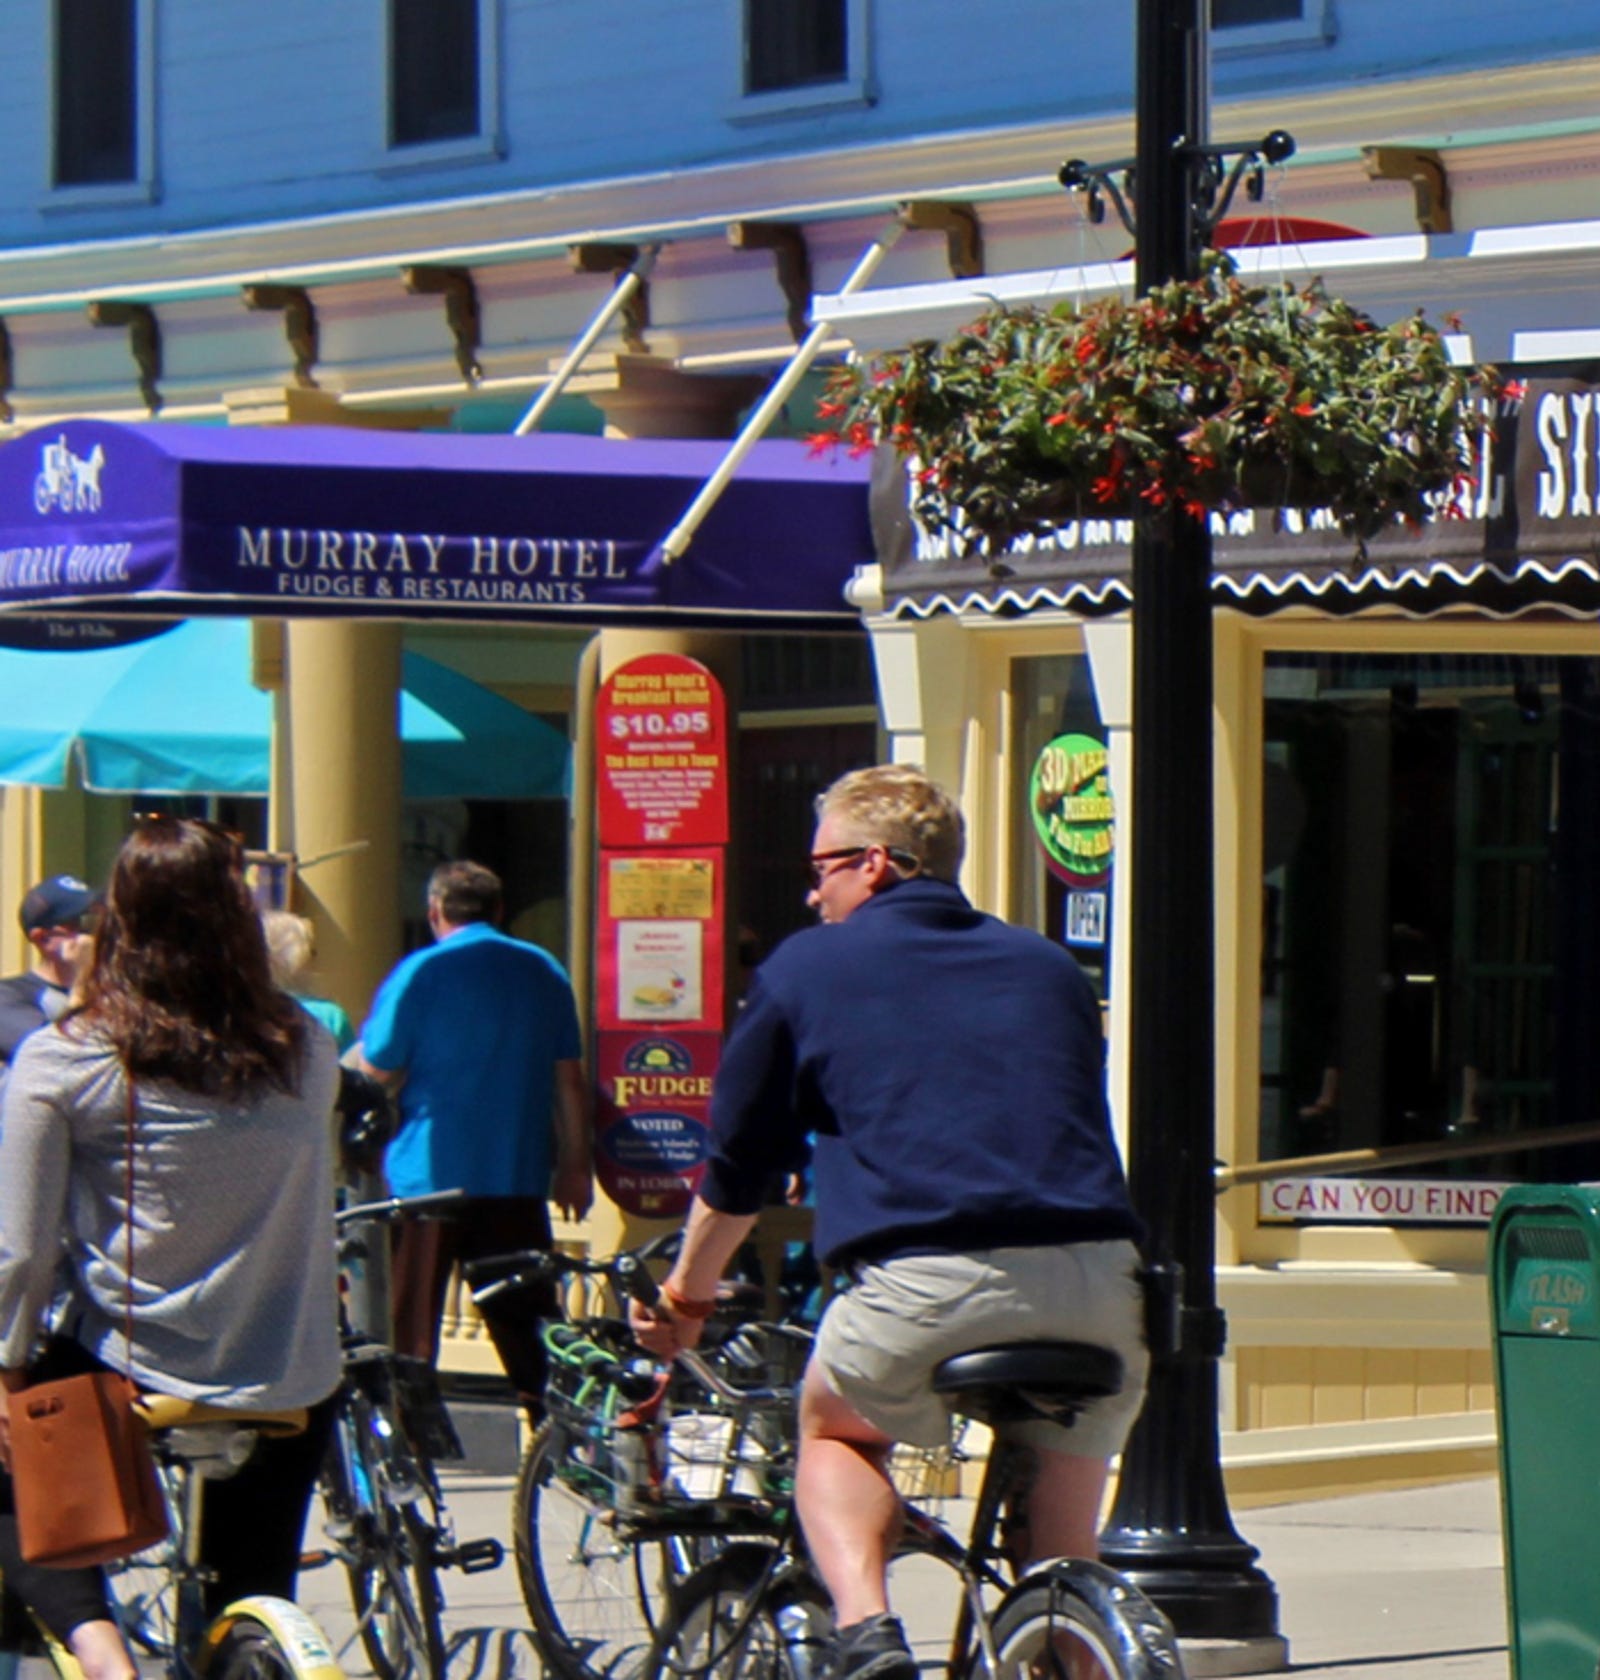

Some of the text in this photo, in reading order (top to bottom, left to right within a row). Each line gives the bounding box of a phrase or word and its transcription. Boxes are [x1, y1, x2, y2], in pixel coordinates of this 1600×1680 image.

[237, 526, 627, 578] MURRAY HOTEL
[278, 573, 585, 602] FUDGE & RESTAURANTS
[610, 711, 710, 738] $10.95
[1042, 746, 1069, 793] 3D
[1070, 893, 1101, 936] OPEN
[631, 1118, 685, 1132] VOTED
[1272, 1183, 1340, 1213] CAN
[1353, 1186, 1414, 1214] YOU
[1529, 1273, 1585, 1304] TRASH
